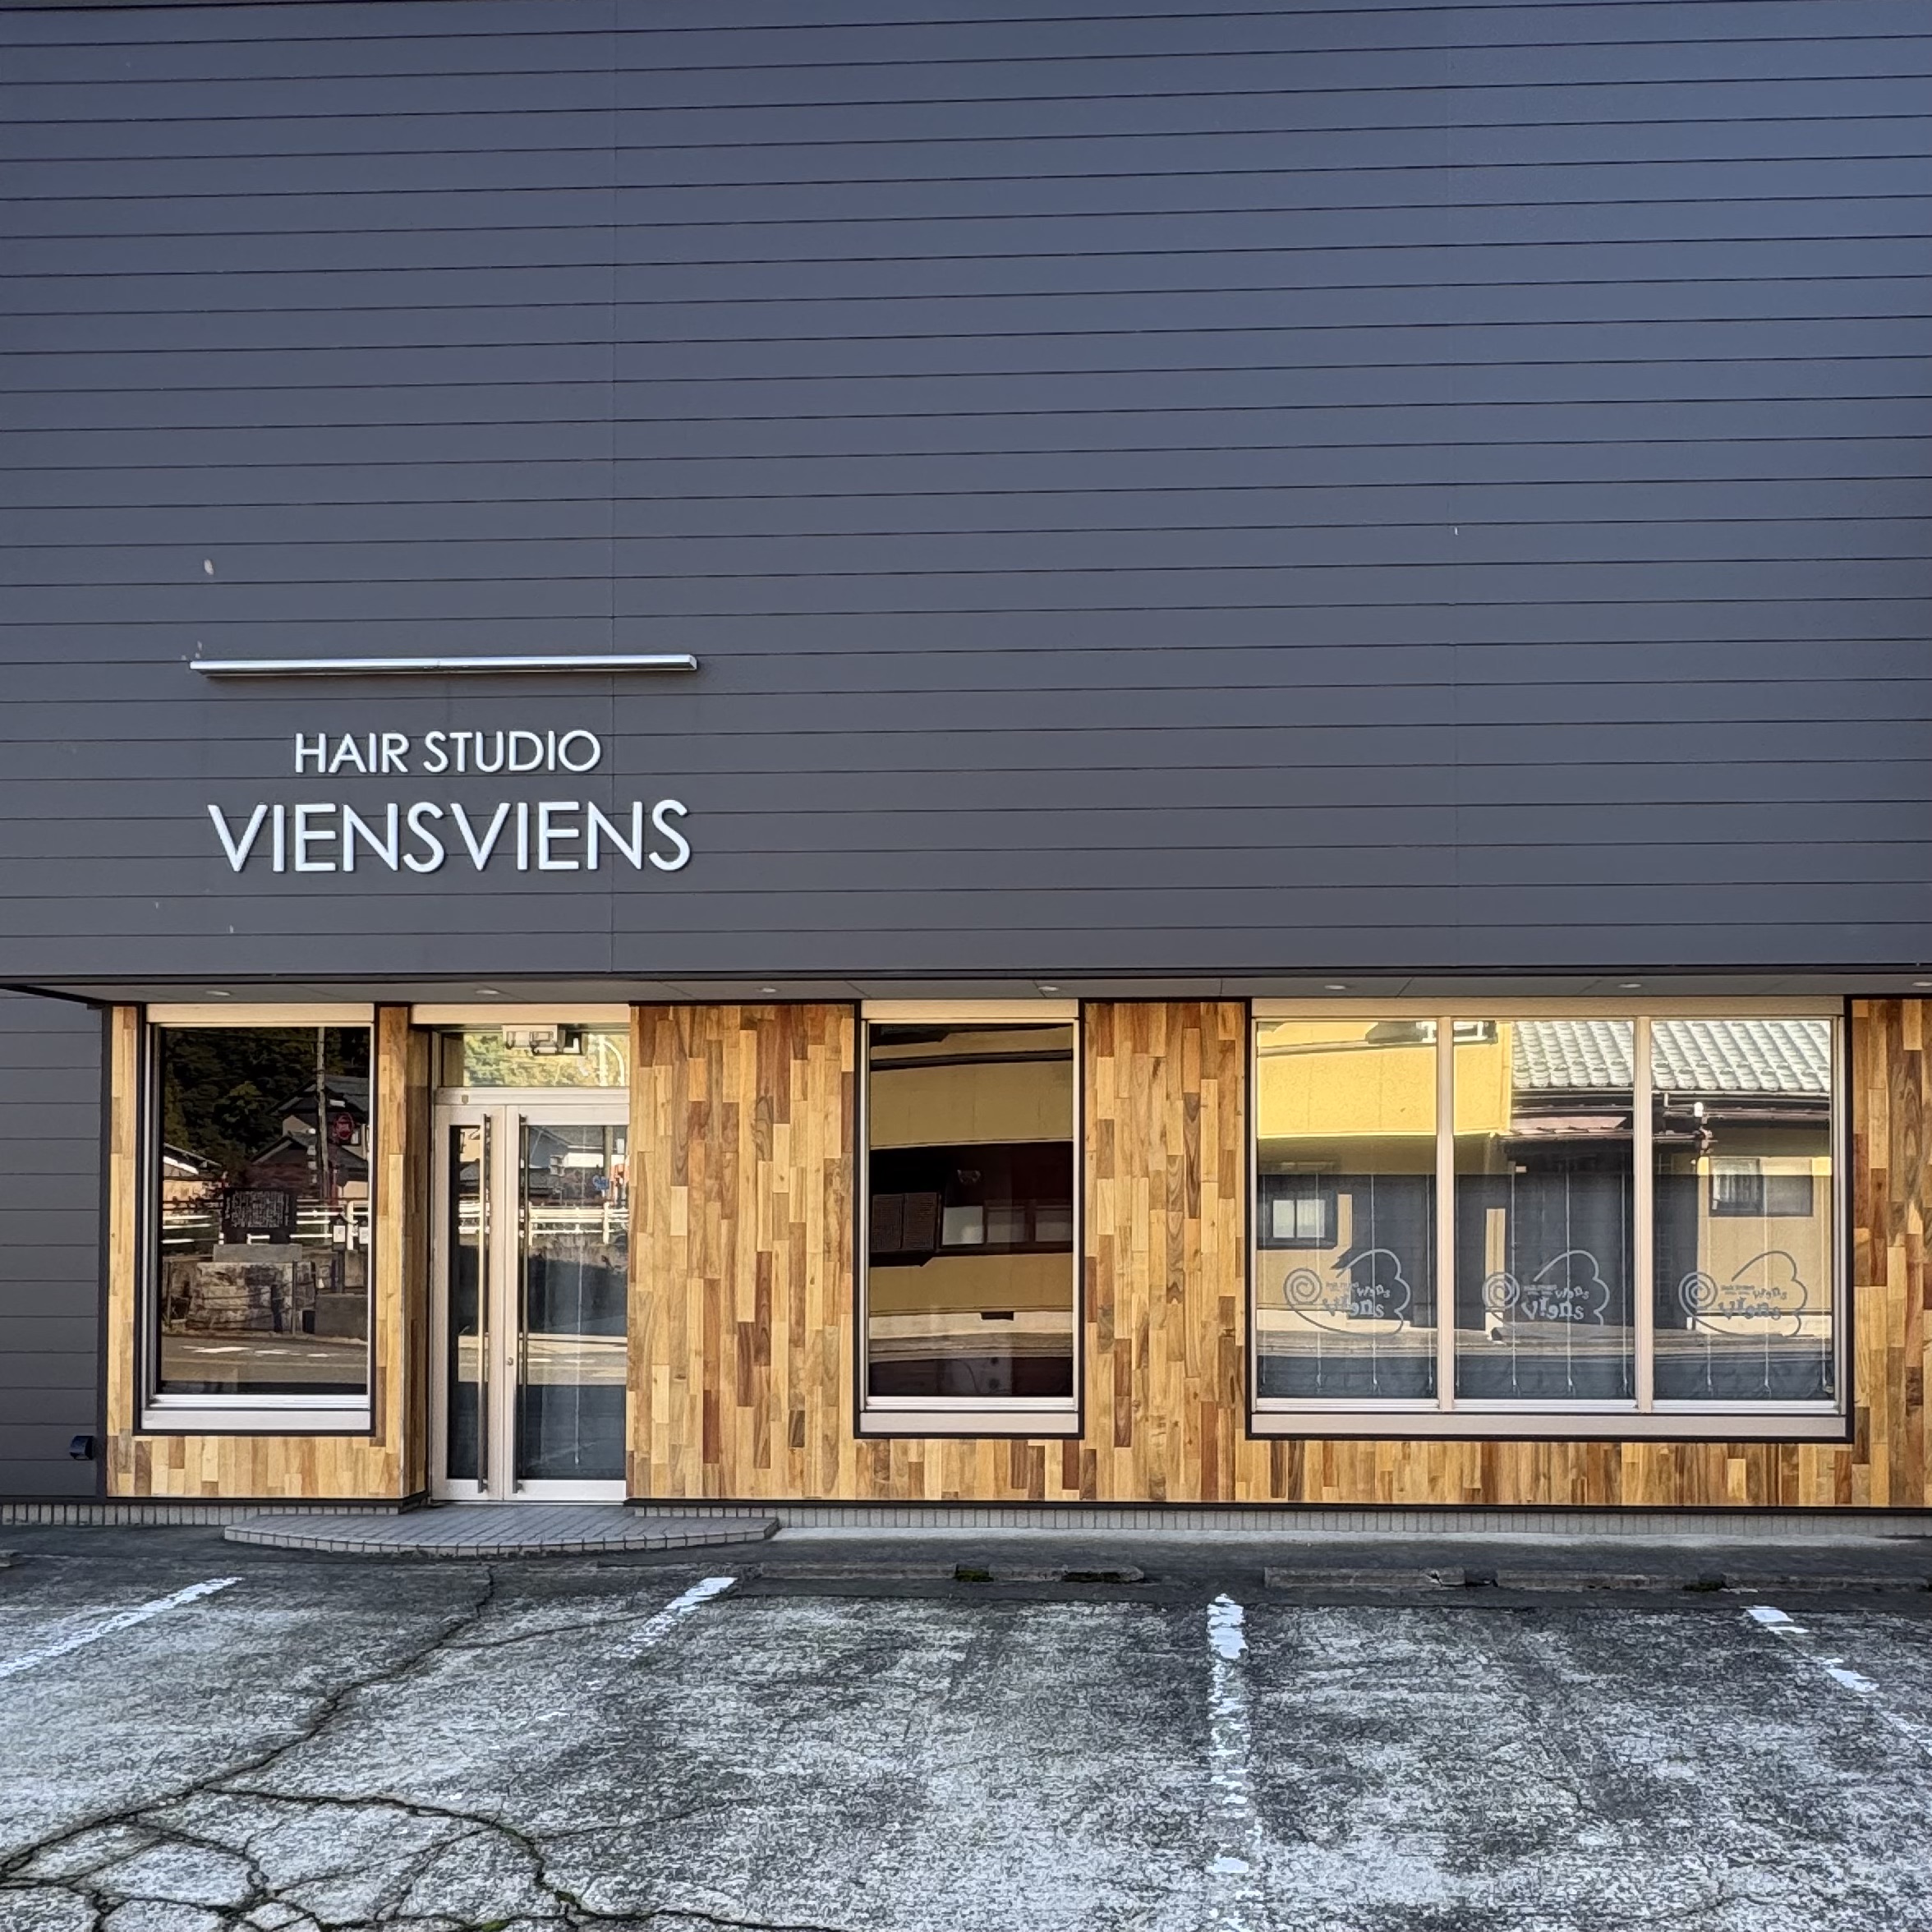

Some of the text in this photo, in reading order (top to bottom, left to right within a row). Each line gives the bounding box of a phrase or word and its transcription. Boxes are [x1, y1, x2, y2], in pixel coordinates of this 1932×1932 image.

[294, 729, 601, 774] HAIR STUDIO
[206, 798, 691, 873] VIENSVIENS
